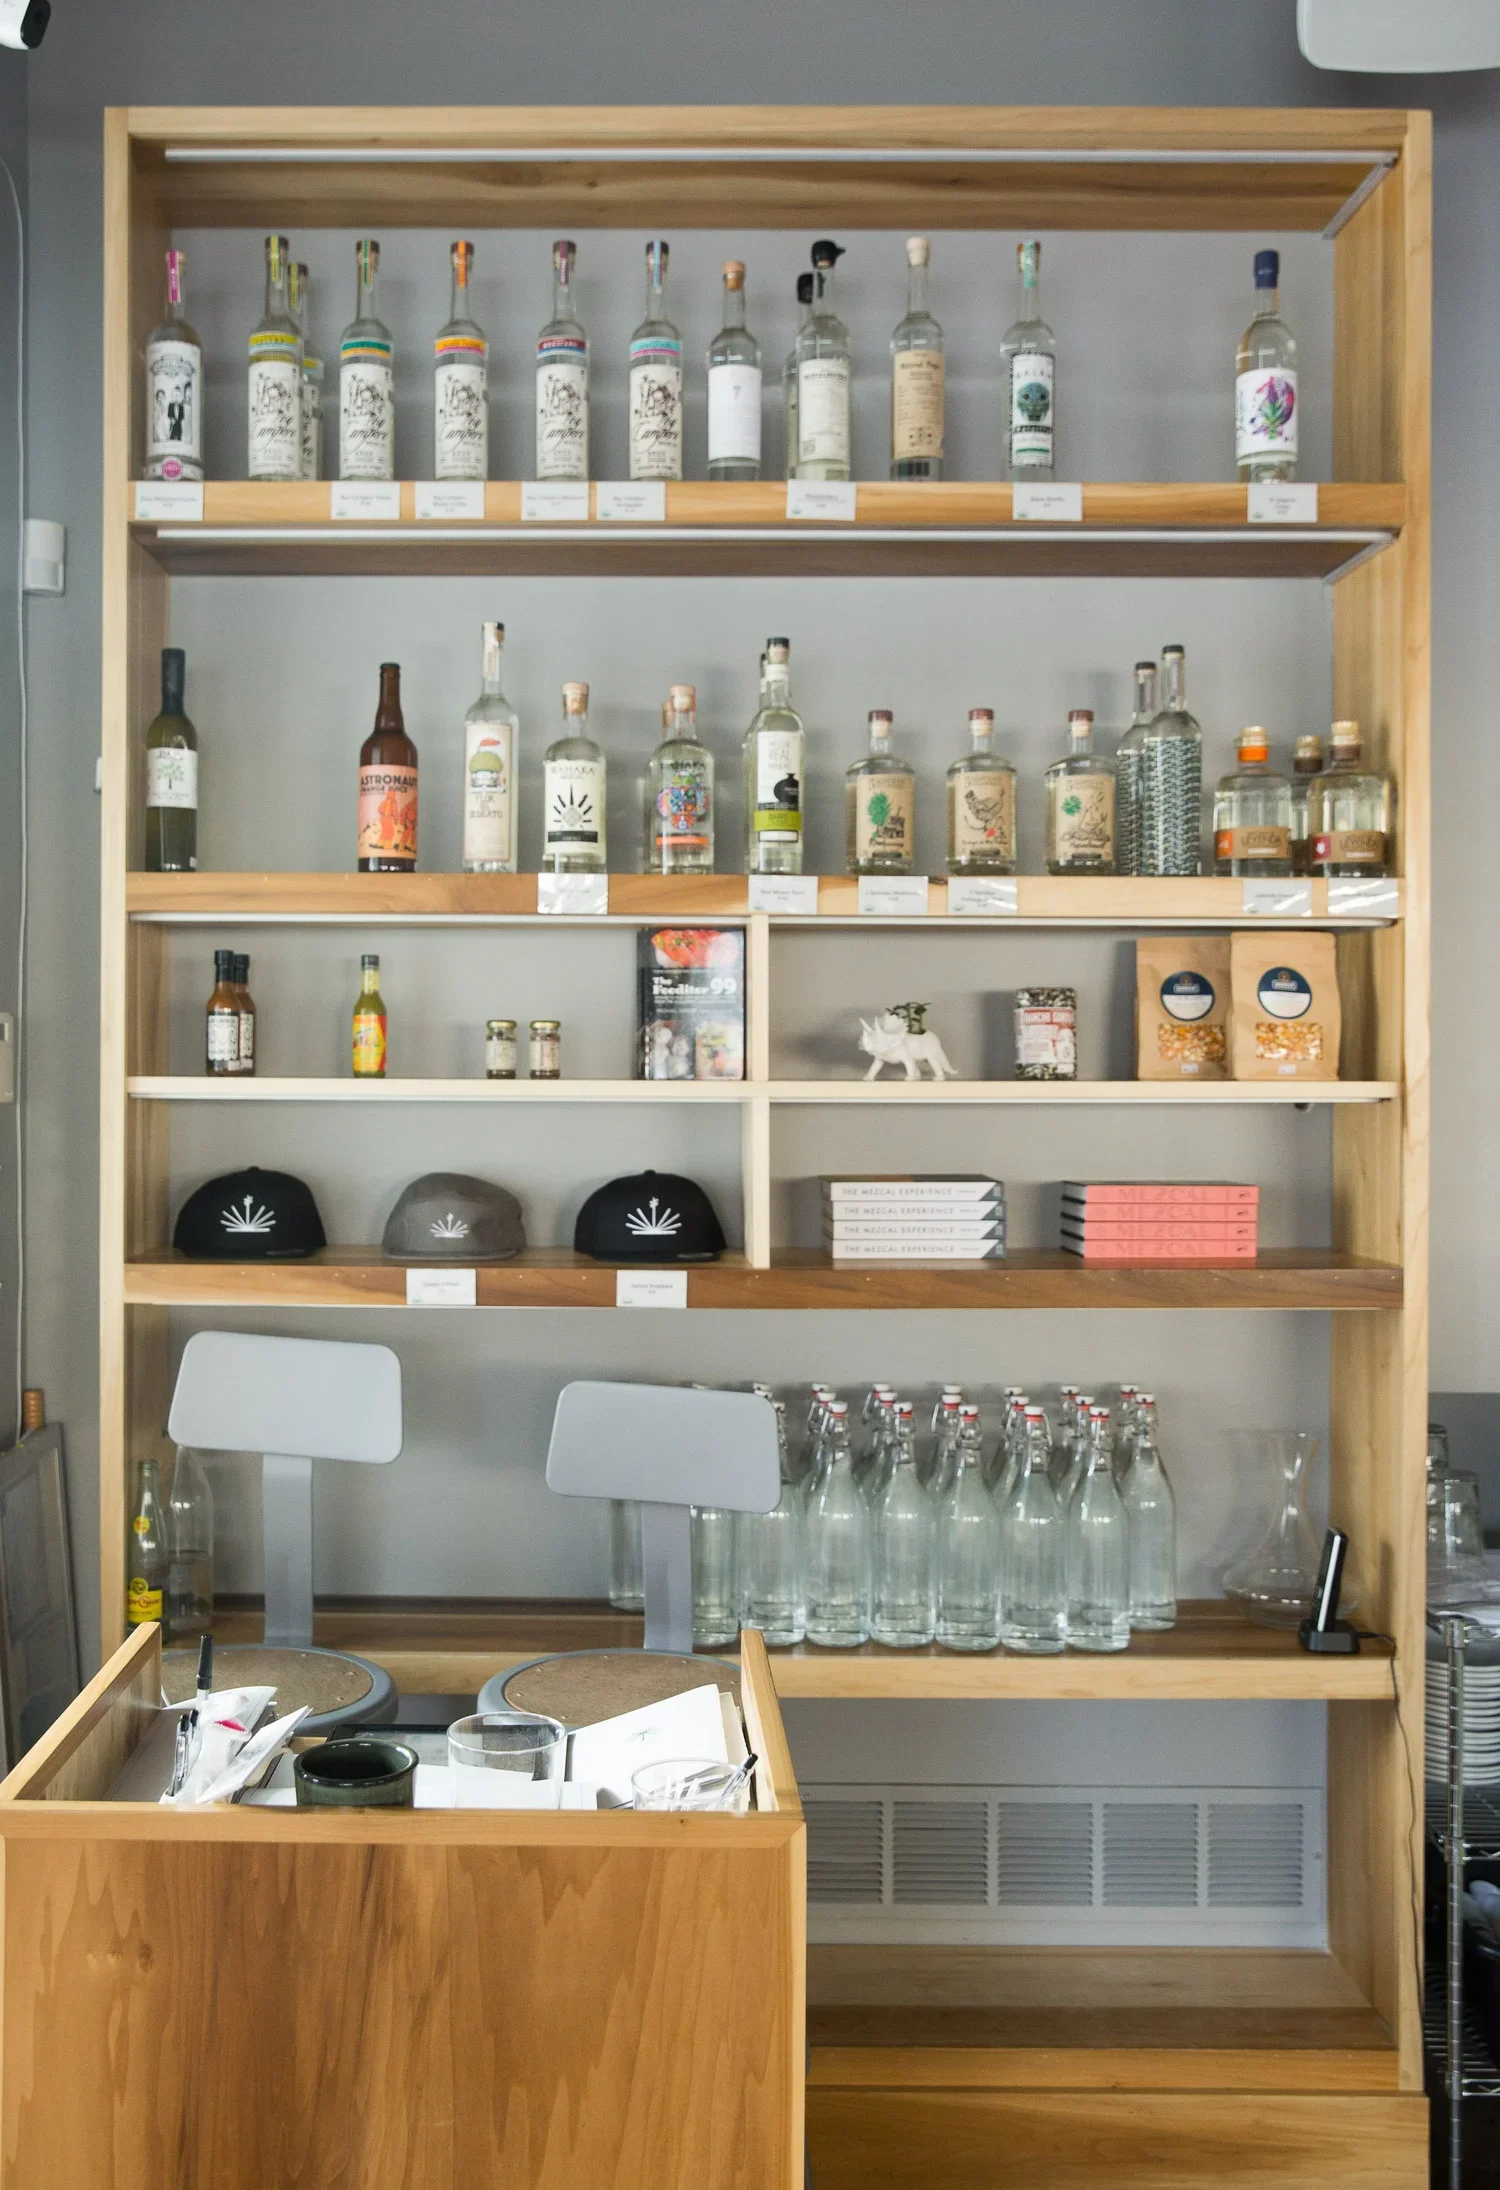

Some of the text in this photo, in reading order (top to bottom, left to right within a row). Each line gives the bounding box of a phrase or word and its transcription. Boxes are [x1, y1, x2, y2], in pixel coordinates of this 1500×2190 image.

[710, 977, 737, 996] 99
[842, 1187, 857, 1196] THE
[861, 1187, 896, 1196] MEZCAL
[899, 1187, 952, 1196] EXPERIENCE
[844, 1206, 859, 1215] THE
[863, 1206, 898, 1215] MEZCAL
[901, 1206, 955, 1215] EXPERIENCE
[844, 1226, 860, 1234] THE
[863, 1226, 898, 1234] MEZCAL
[900, 1226, 954, 1234] EXPERIENCE
[845, 1245, 860, 1253] THE
[864, 1245, 898, 1253] MEZCAL
[901, 1245, 955, 1253] EXPERIENCE
